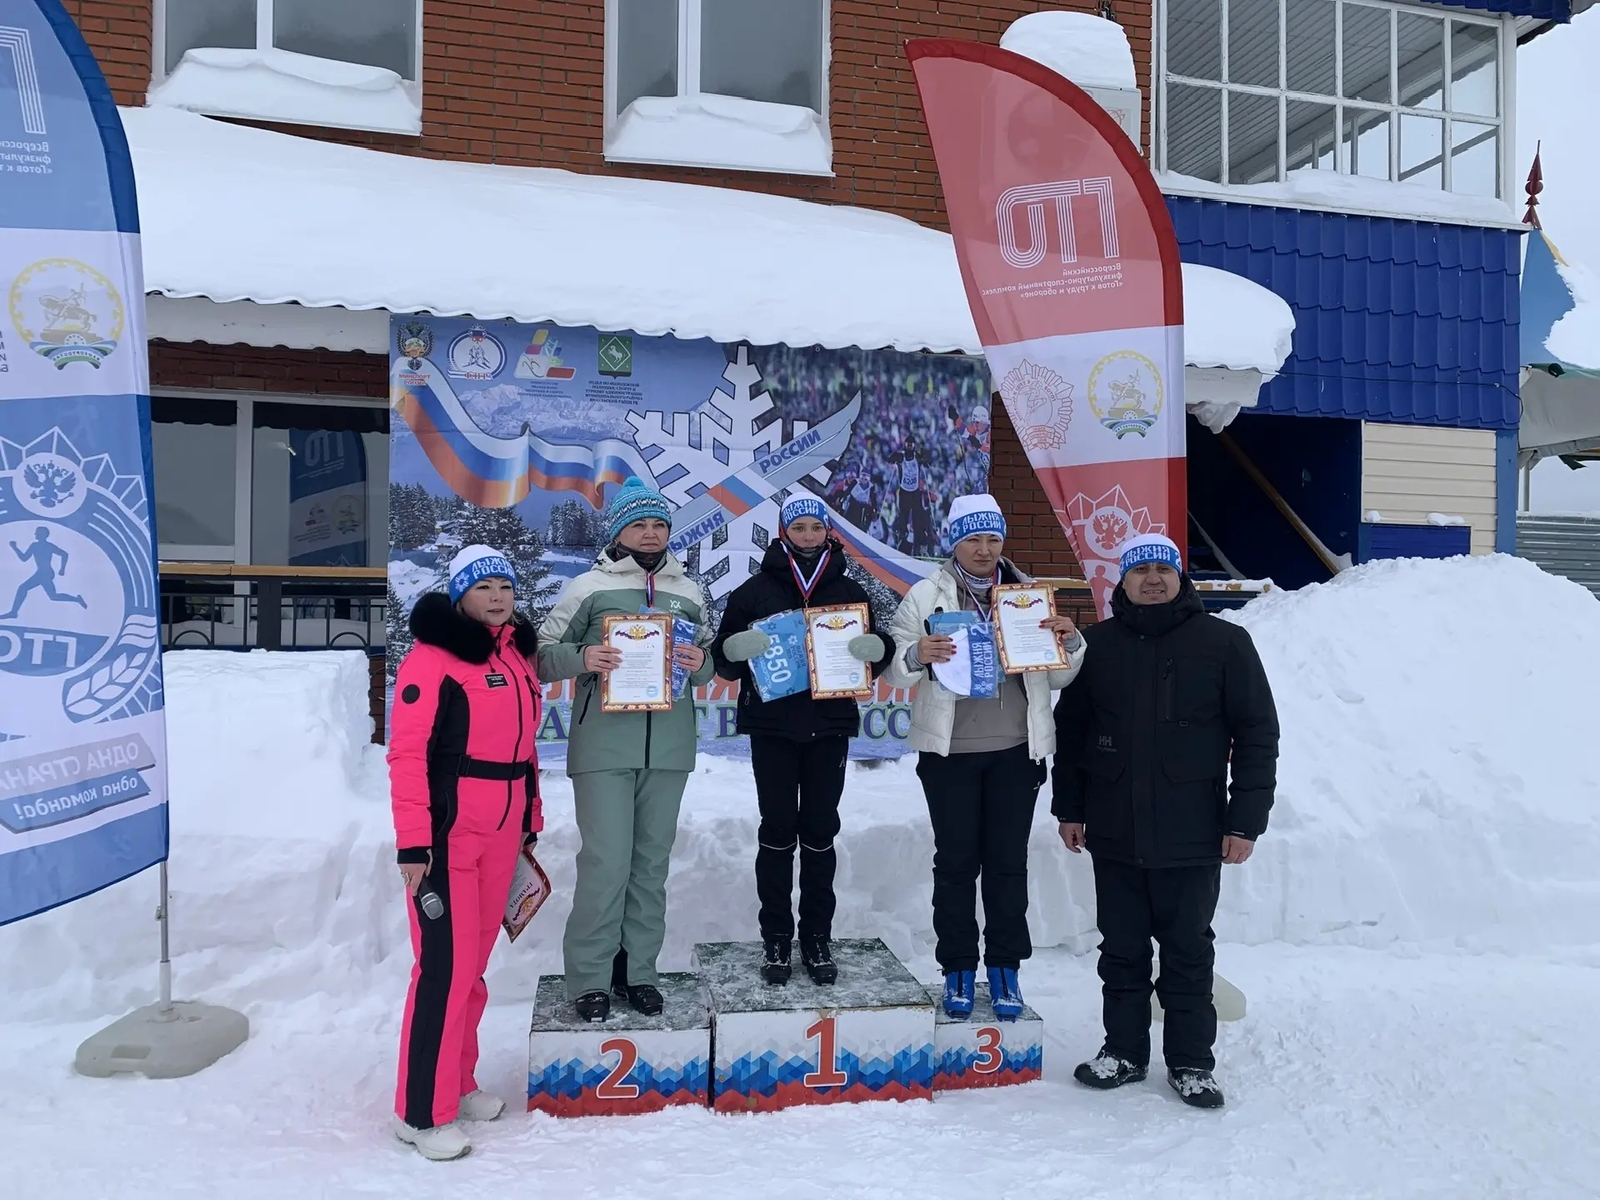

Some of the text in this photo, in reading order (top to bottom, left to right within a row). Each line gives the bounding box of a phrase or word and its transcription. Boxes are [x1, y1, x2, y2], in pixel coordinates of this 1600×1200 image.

[759, 429, 822, 474] РОССИИ
[962, 512, 1000, 526] ЛЫЖНЯ
[962, 520, 1002, 533] РОССИИ
[1125, 545, 1170, 560] ЛЫЖНЯ
[1125, 552, 1171, 567] РОССИИ
[972, 642, 984, 678] ЛЫЖНЯ
[982, 641, 994, 678] РОССИИ
[1098, 735, 1113, 747] HH
[595, 1037, 640, 1099] 2
[803, 1016, 848, 1089] 1
[972, 1026, 1004, 1074] 3
